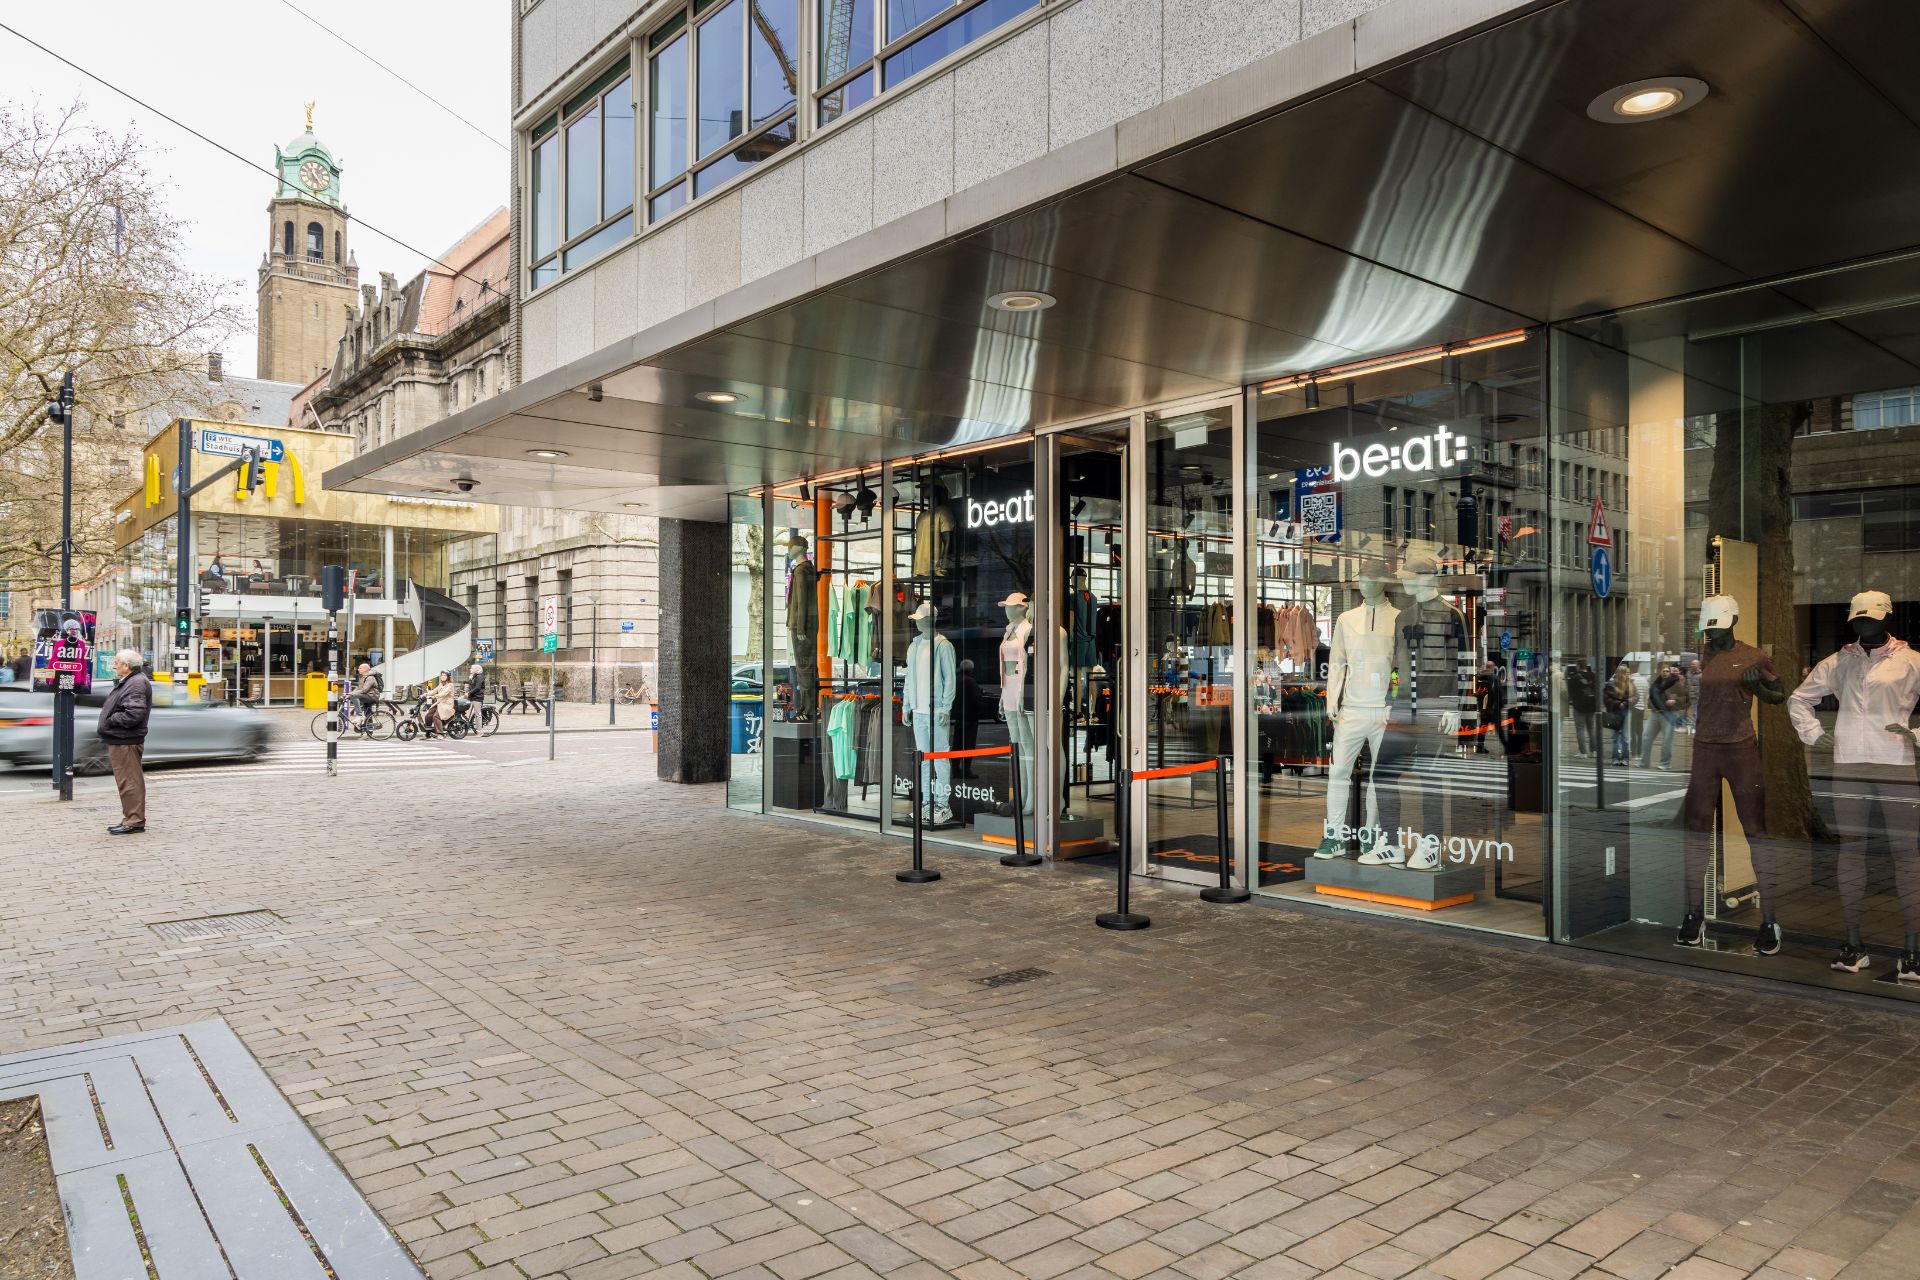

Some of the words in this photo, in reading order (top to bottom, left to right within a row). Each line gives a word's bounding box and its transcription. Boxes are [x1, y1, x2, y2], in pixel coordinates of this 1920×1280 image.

[205, 442, 240, 453] Stadhuis
[1333, 425, 1468, 482] be:at:
[967, 489, 1034, 529] be:at
[35, 641, 54, 660] Zij
[57, 645, 83, 660] aan
[83, 645, 95, 663] Zij
[954, 782, 995, 803] street
[1396, 826, 1440, 852] the
[1448, 836, 1514, 865] gym
